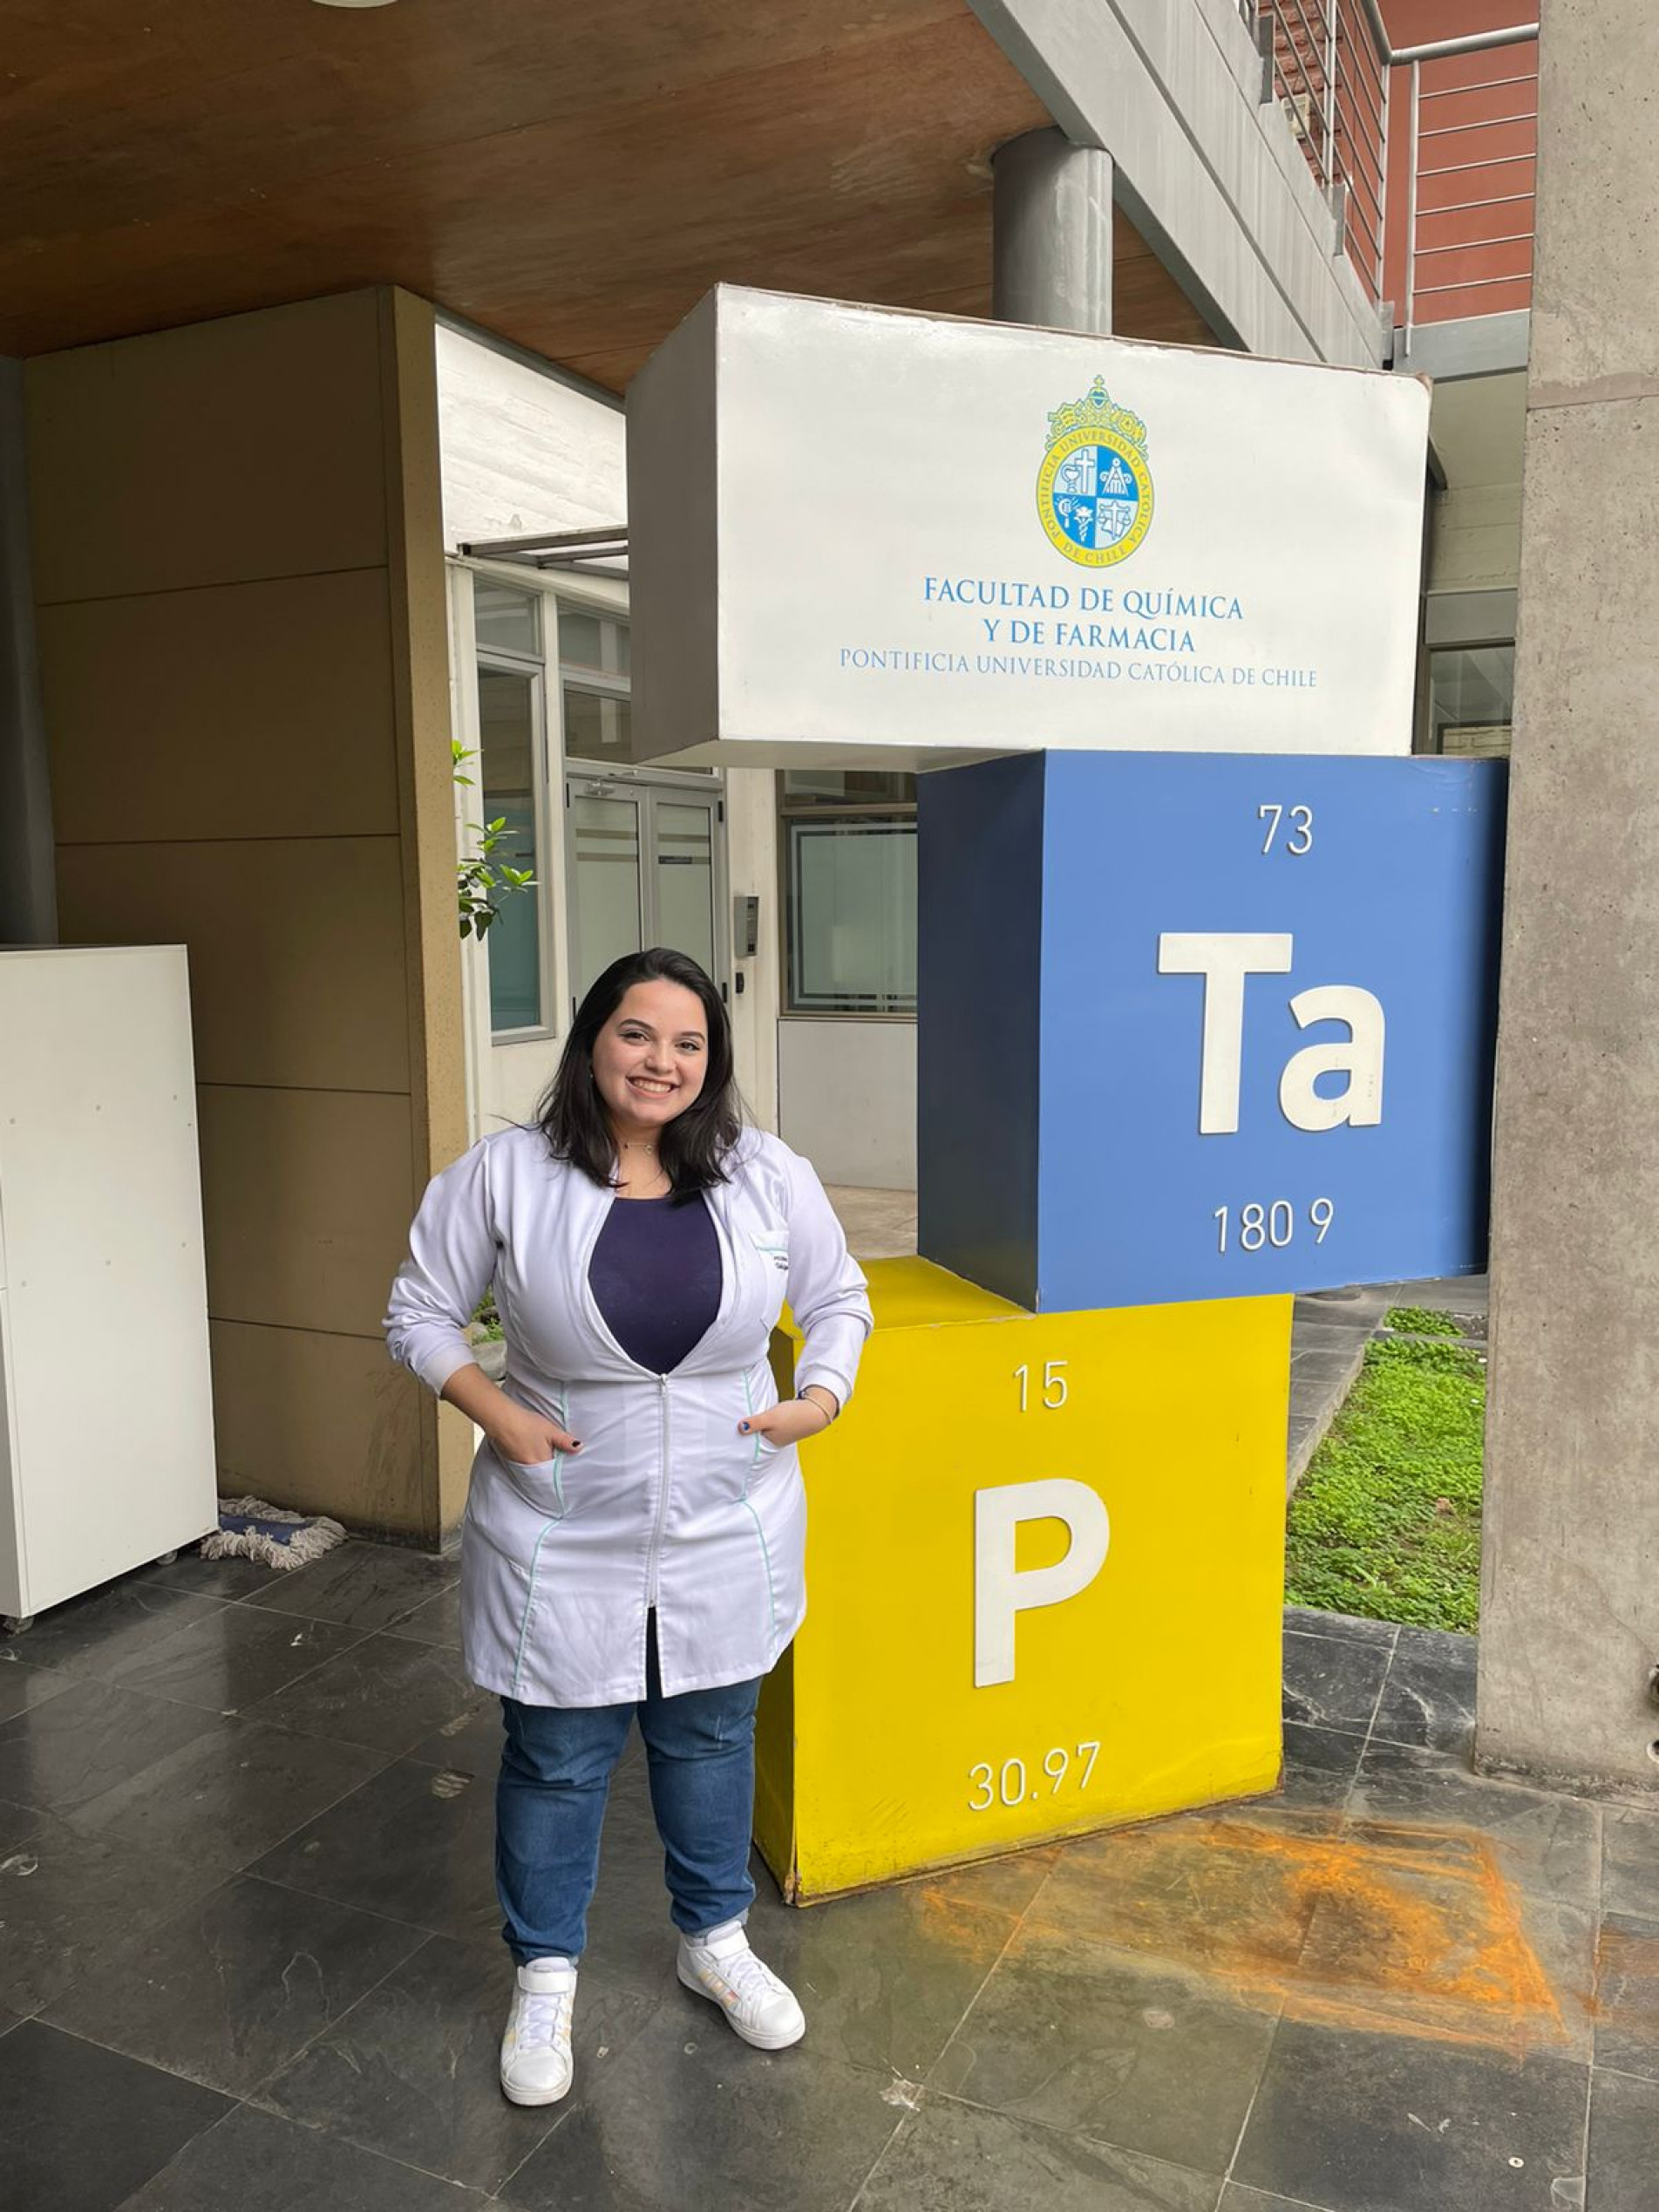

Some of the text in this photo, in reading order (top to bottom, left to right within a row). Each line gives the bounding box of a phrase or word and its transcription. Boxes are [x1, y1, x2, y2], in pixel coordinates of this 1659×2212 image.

[1061, 430, 1140, 468] UNIVERSIDAD
[1063, 542, 1080, 557] DE
[1084, 546, 1127, 564] CHILE
[925, 577, 1243, 620] FACULTAD DE QUÍMICA
[983, 619, 1194, 652] Y DE FARMACIA
[840, 649, 1317, 687] PONTIFICIA UNIVERSIDAD CATÓLICA DE CHILE
[1258, 805, 1313, 854] 73
[1158, 932, 1386, 1134] Ta
[1014, 1360, 1068, 1412] 15
[974, 1478, 1110, 1688] P
[969, 1741, 1101, 1811] 30.97
